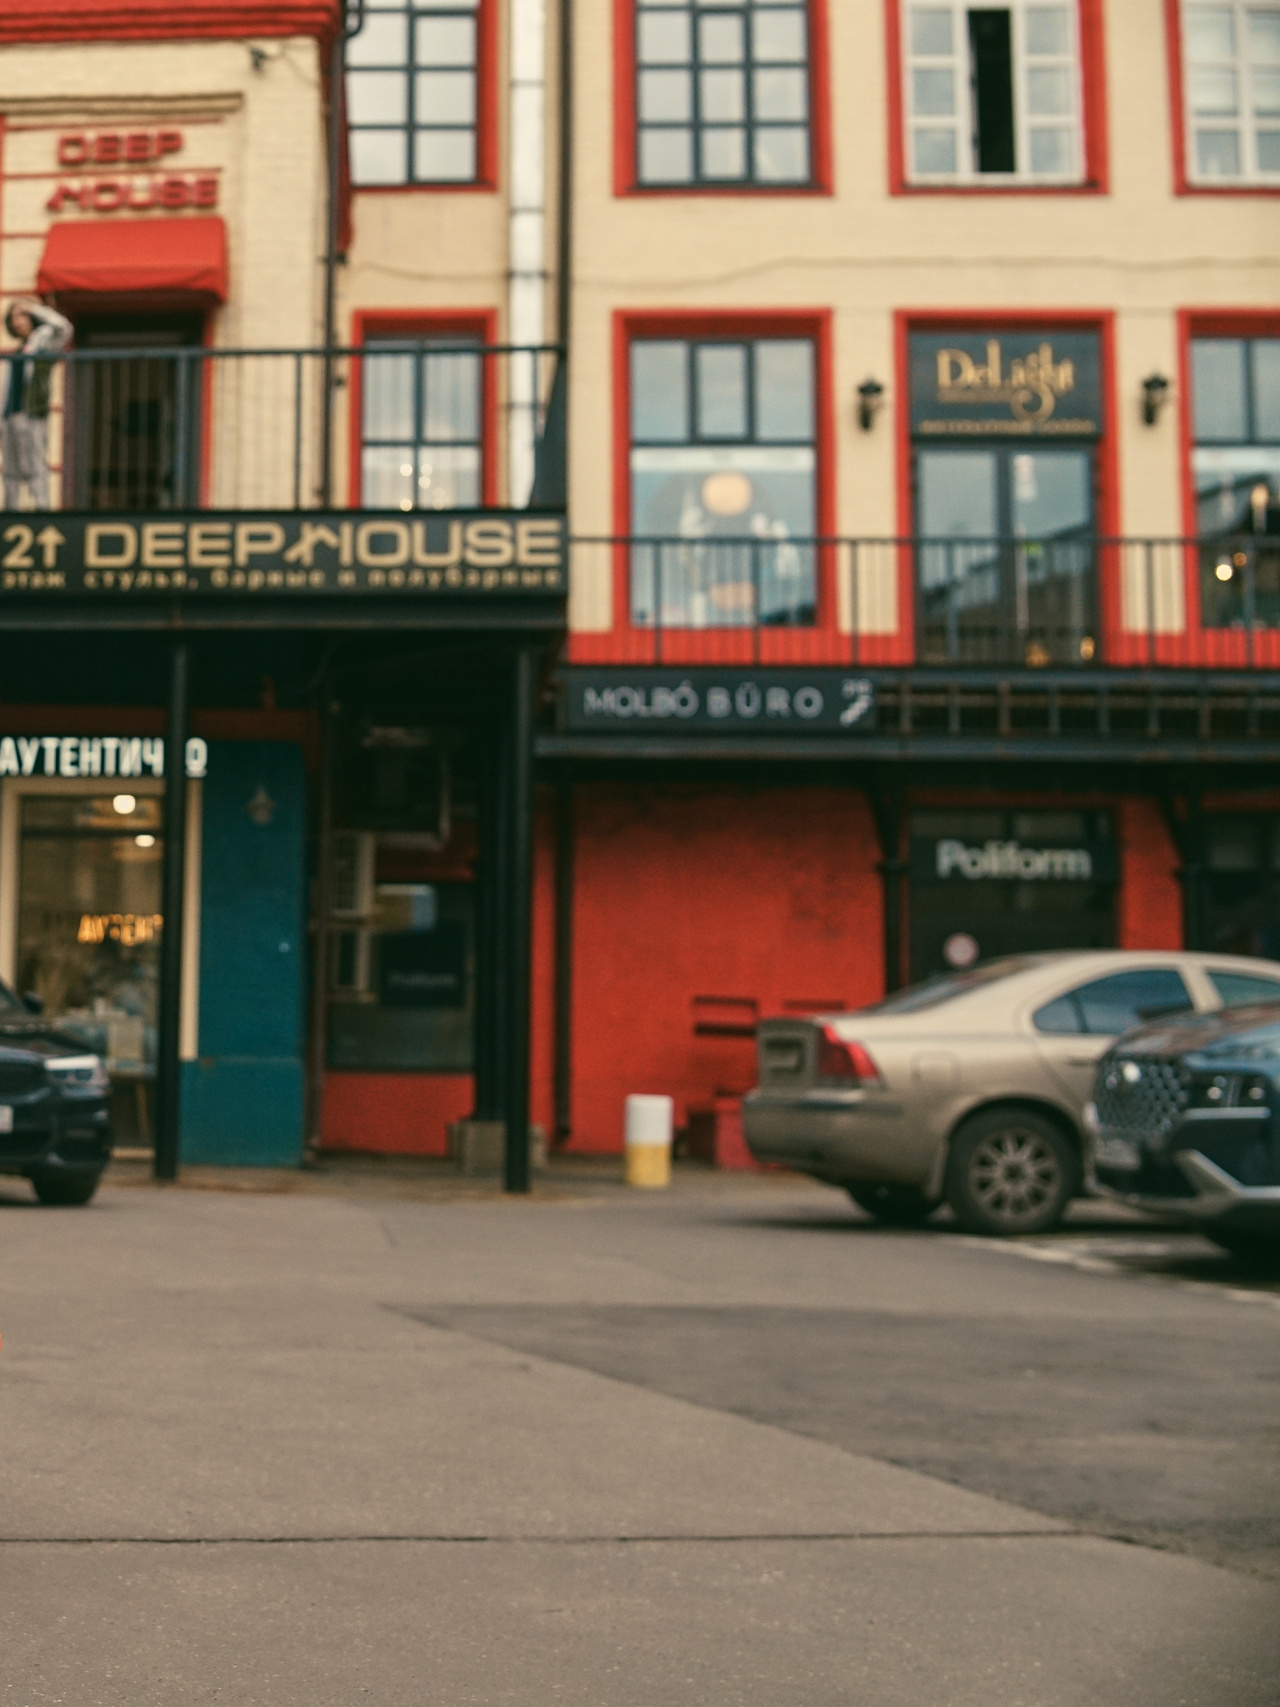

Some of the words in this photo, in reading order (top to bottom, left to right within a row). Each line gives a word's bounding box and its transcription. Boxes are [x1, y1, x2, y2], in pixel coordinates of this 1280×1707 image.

[58, 130, 184, 166] DEEP
[0, 523, 36, 569] 2
[82, 519, 287, 569] DEEP
[935, 839, 1092, 880] Poliform
